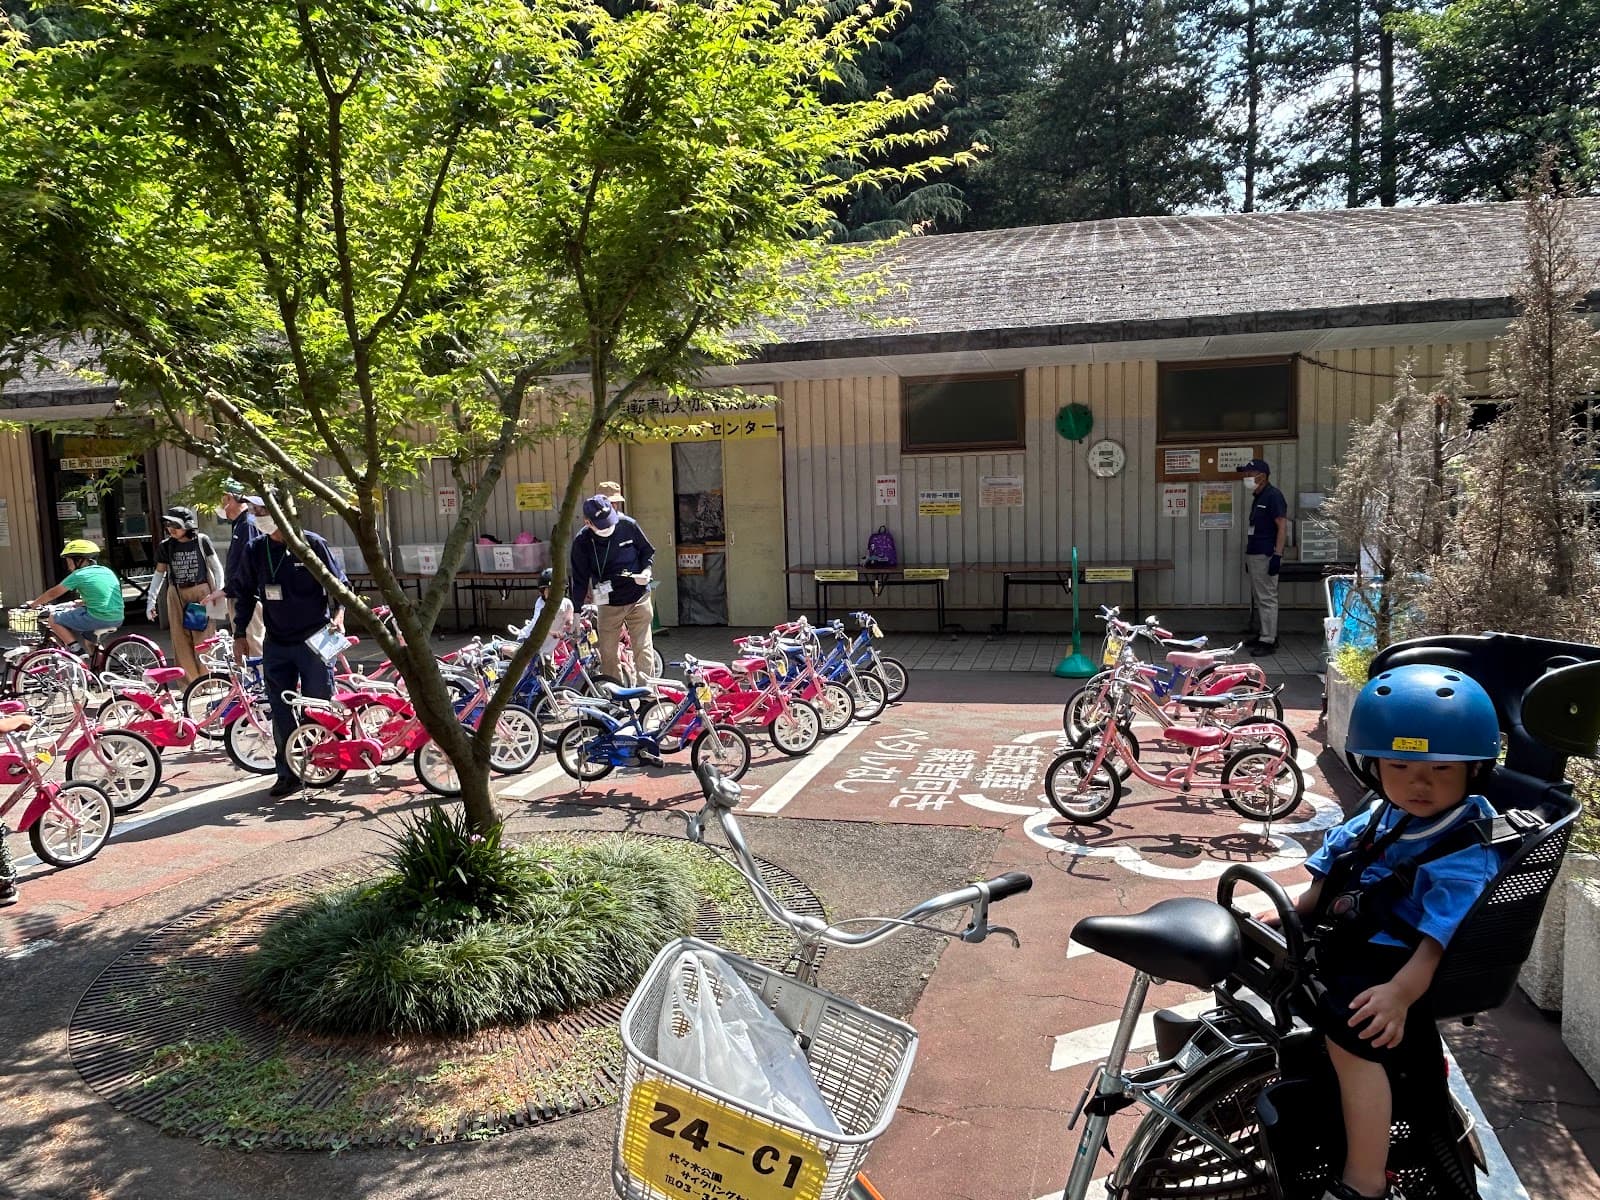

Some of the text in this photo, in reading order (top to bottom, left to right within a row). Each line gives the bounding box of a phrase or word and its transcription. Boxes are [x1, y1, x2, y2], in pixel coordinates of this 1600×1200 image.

[1167, 498, 1186, 509] 1回
[833, 728, 930, 793] ペダルなし
[889, 748, 977, 811] 練習向き
[669, 1152, 723, 1184] 代々木公園
